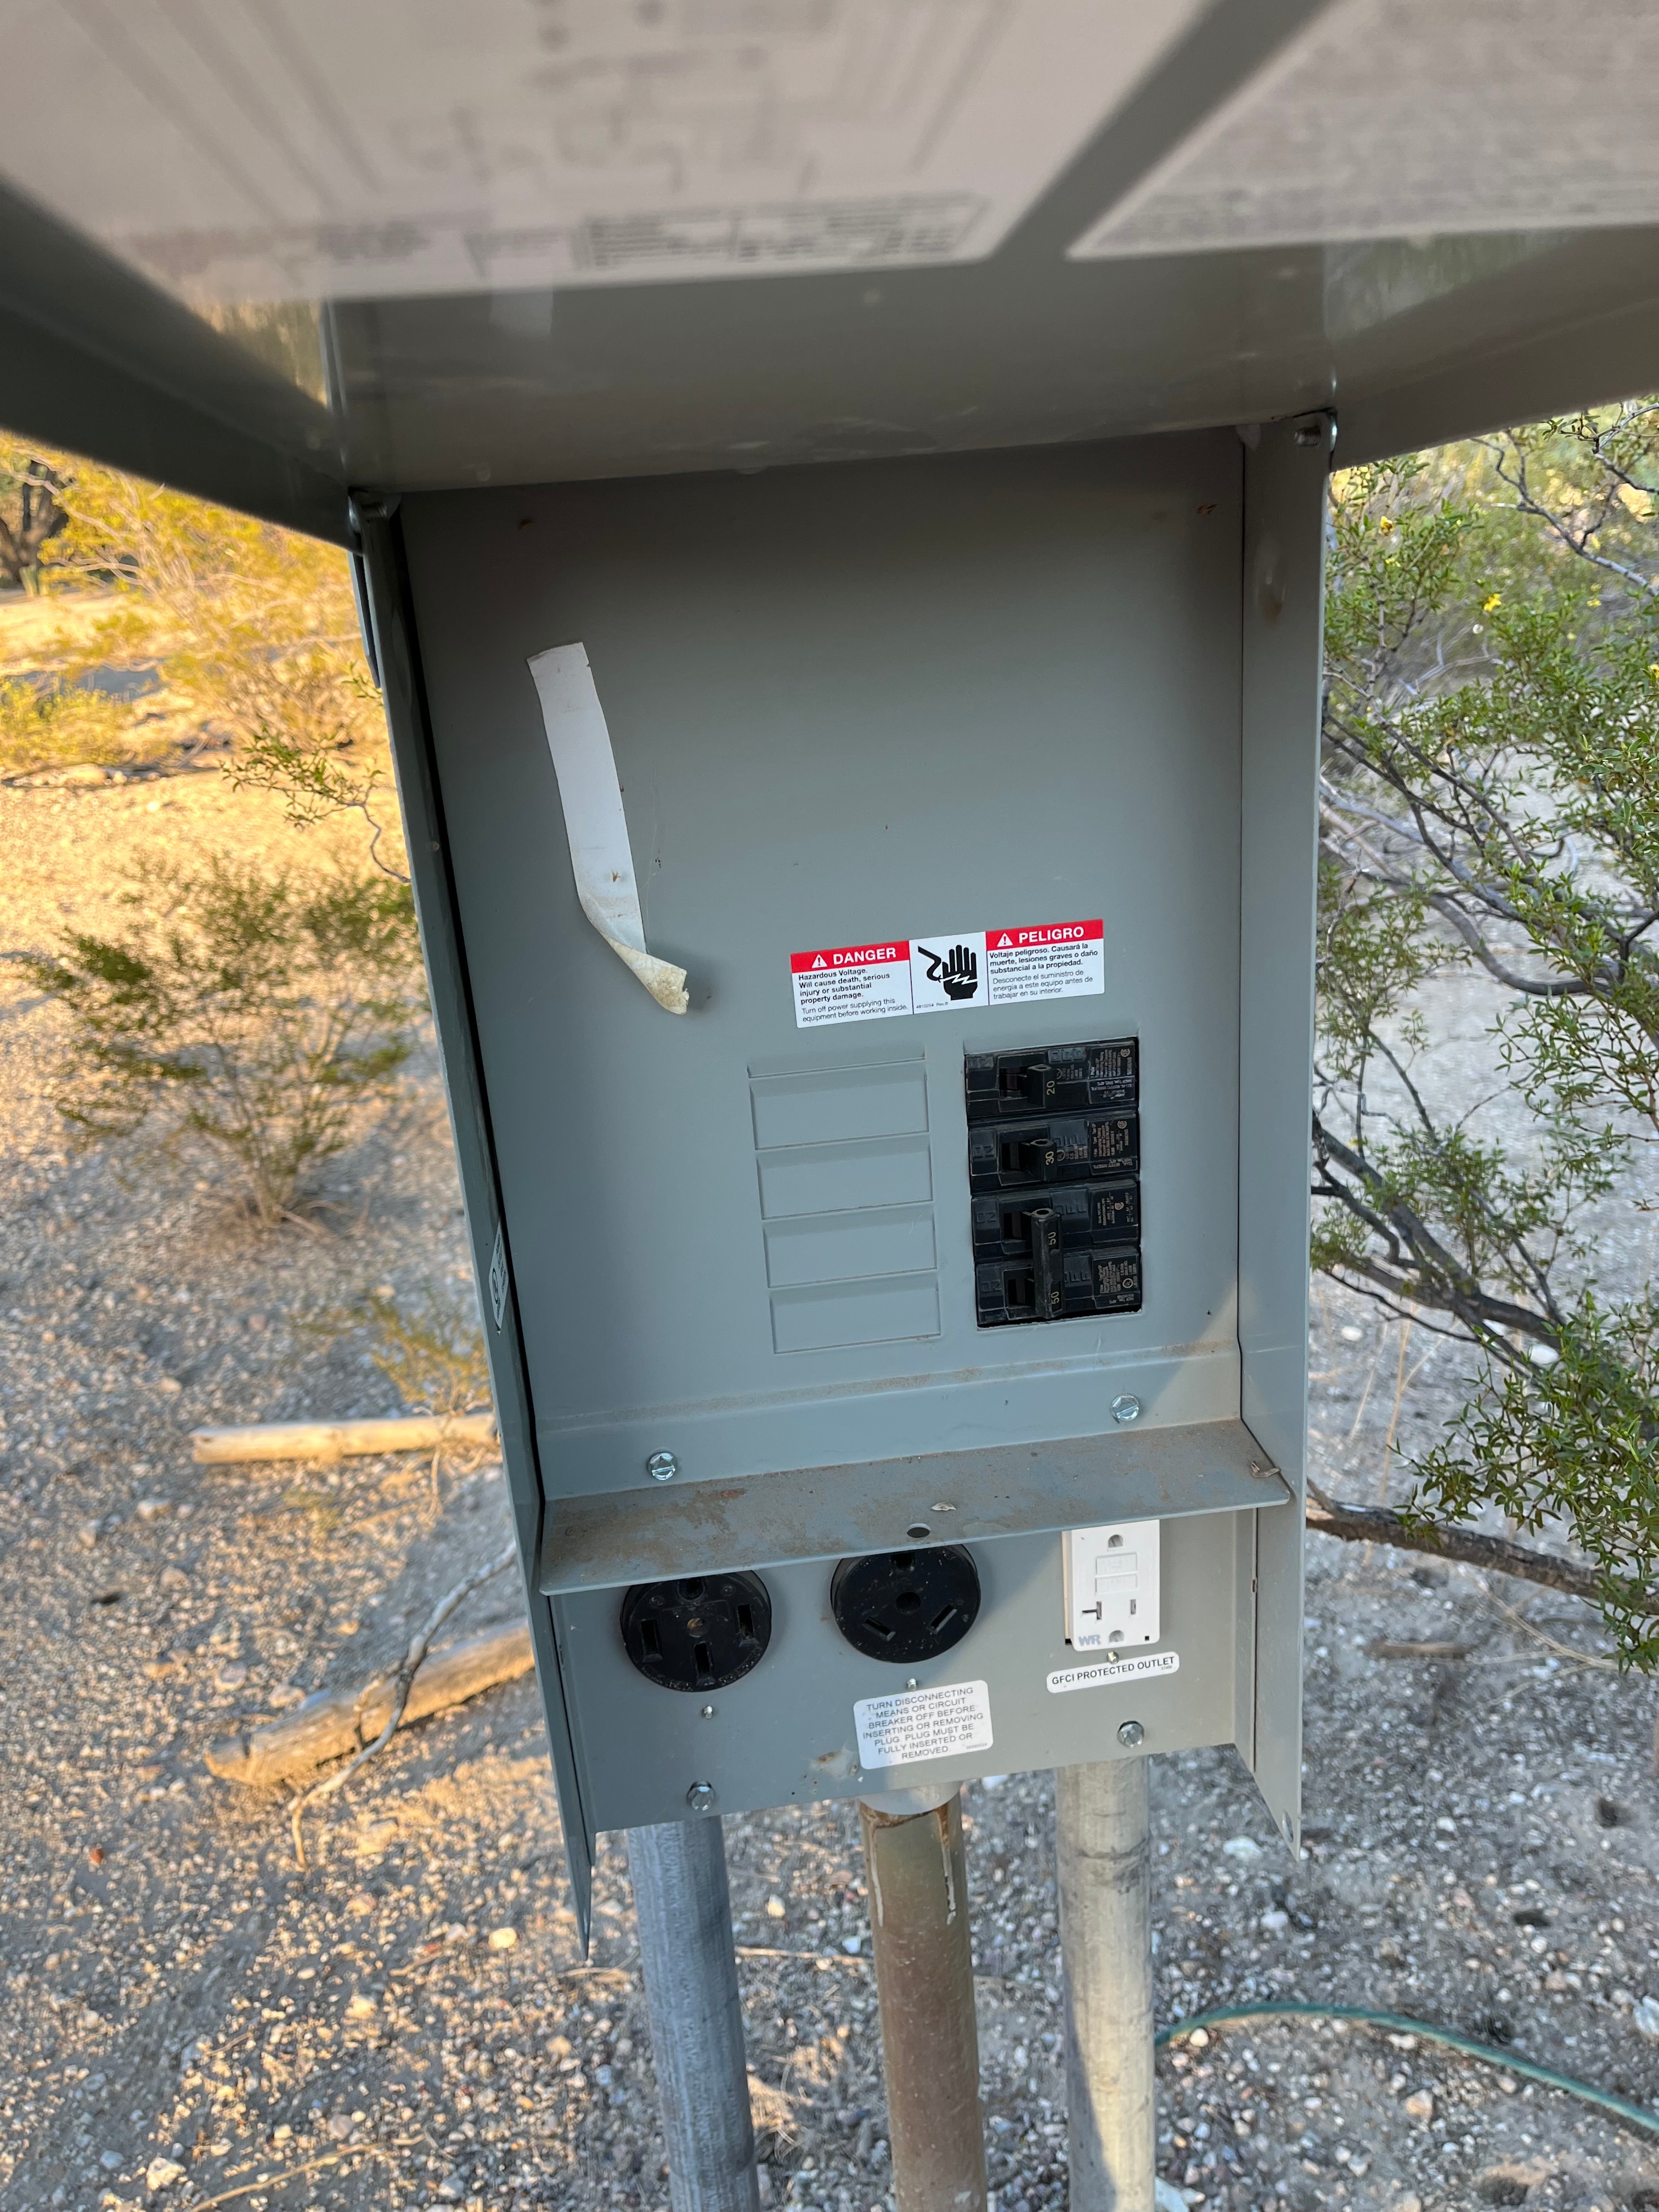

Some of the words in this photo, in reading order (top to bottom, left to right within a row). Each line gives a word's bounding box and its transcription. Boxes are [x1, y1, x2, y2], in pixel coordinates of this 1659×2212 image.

[1019, 926, 1084, 944] PELIGRO
[833, 947, 896, 965] DANGER
[989, 950, 1013, 958] Voltaje
[1015, 947, 1049, 957] peligroso.
[1051, 943, 1080, 952] Causará
[1049, 952, 1073, 961] graves
[990, 964, 1030, 974] substancial
[1046, 959, 1083, 969] propiedad.
[799, 971, 837, 981] Hazardous
[839, 968, 868, 978] Voltage.
[838, 975, 861, 984] death,
[863, 973, 890, 981] serious
[993, 975, 1031, 985] Desconecte
[1041, 971, 1074, 979] suministro
[800, 989, 820, 997] injury
[832, 982, 872, 993] substantial
[993, 984, 1017, 993] energía
[1041, 979, 1063, 988] equipo
[801, 996, 831, 1006] property
[832, 992, 864, 1002] damage.
[993, 992, 1018, 1001] trabajar
[828, 1003, 848, 1012] power
[850, 1000, 882, 1009] supplying
[803, 1012, 837, 1022] equipment
[860, 1006, 885, 1016] working
[1046, 1080, 1056, 1096] 20
[1045, 1151, 1054, 1166] 30
[1048, 1232, 1057, 1246] 50
[1051, 1291, 1060, 1305] 50
[1078, 1634, 1102, 1647] WR
[1052, 1672, 1075, 1685] GFCI
[1077, 1663, 1135, 1681] PROTECTED
[1137, 1656, 1175, 1670] OUTLET
[867, 1701, 893, 1712] TURN
[895, 1687, 974, 1707] DISCONNECTING
[876, 1707, 909, 1719] MEANS
[912, 1705, 926, 1713] OR
[928, 1697, 967, 1710] CIRCUIT
[868, 1716, 913, 1729] BREAKER
[916, 1712, 935, 1722] OFF
[938, 1705, 976, 1718] BEFORE
[863, 1724, 914, 1739] INSERTING
[916, 1722, 930, 1730] OR
[933, 1712, 984, 1727] REMOVING
[905, 1731, 930, 1742] PLUG
[933, 1726, 959, 1736] MUST
[961, 1723, 974, 1731] BE
[878, 1744, 907, 1755] FULLY
[910, 1735, 956, 1750] INSERTED
[958, 1732, 973, 1740] OR
